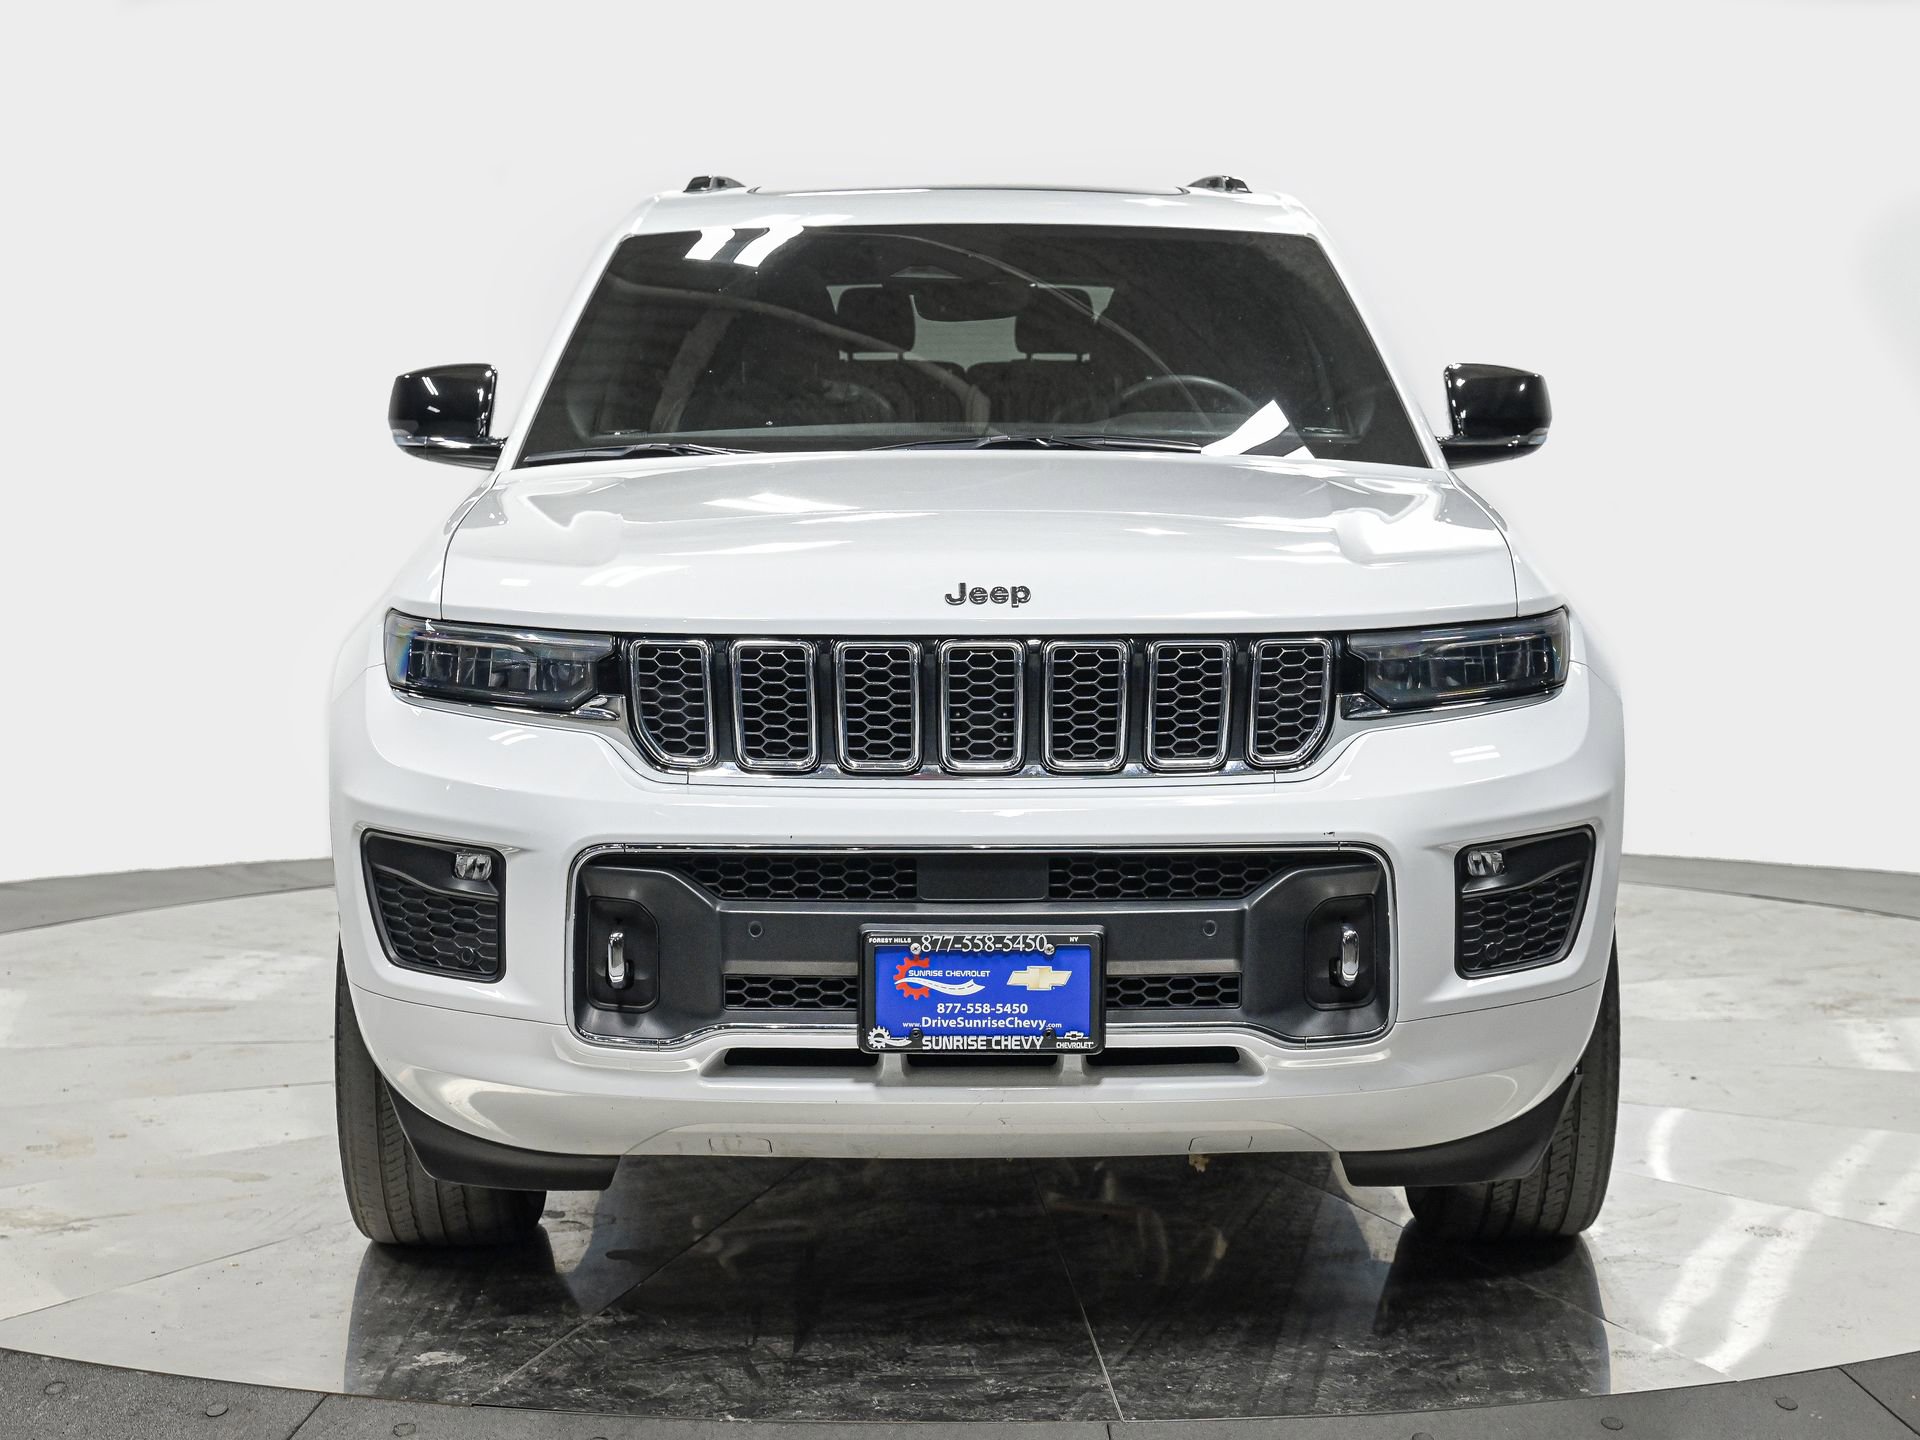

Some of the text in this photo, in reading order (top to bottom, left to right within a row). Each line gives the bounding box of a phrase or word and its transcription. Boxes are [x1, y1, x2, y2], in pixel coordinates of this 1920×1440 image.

[945, 582, 1031, 608] Jeep
[921, 934, 1048, 952] 877-558-5450
[908, 969, 943, 977] SUNRISE
[936, 1003, 1029, 1014] 877-558-5450
[902, 1016, 1063, 1030] www.DriveSunriseChevy.com
[921, 1035, 1044, 1050] SUNRISE CHEVY
[1055, 1041, 1091, 1049] CHEVROLET
